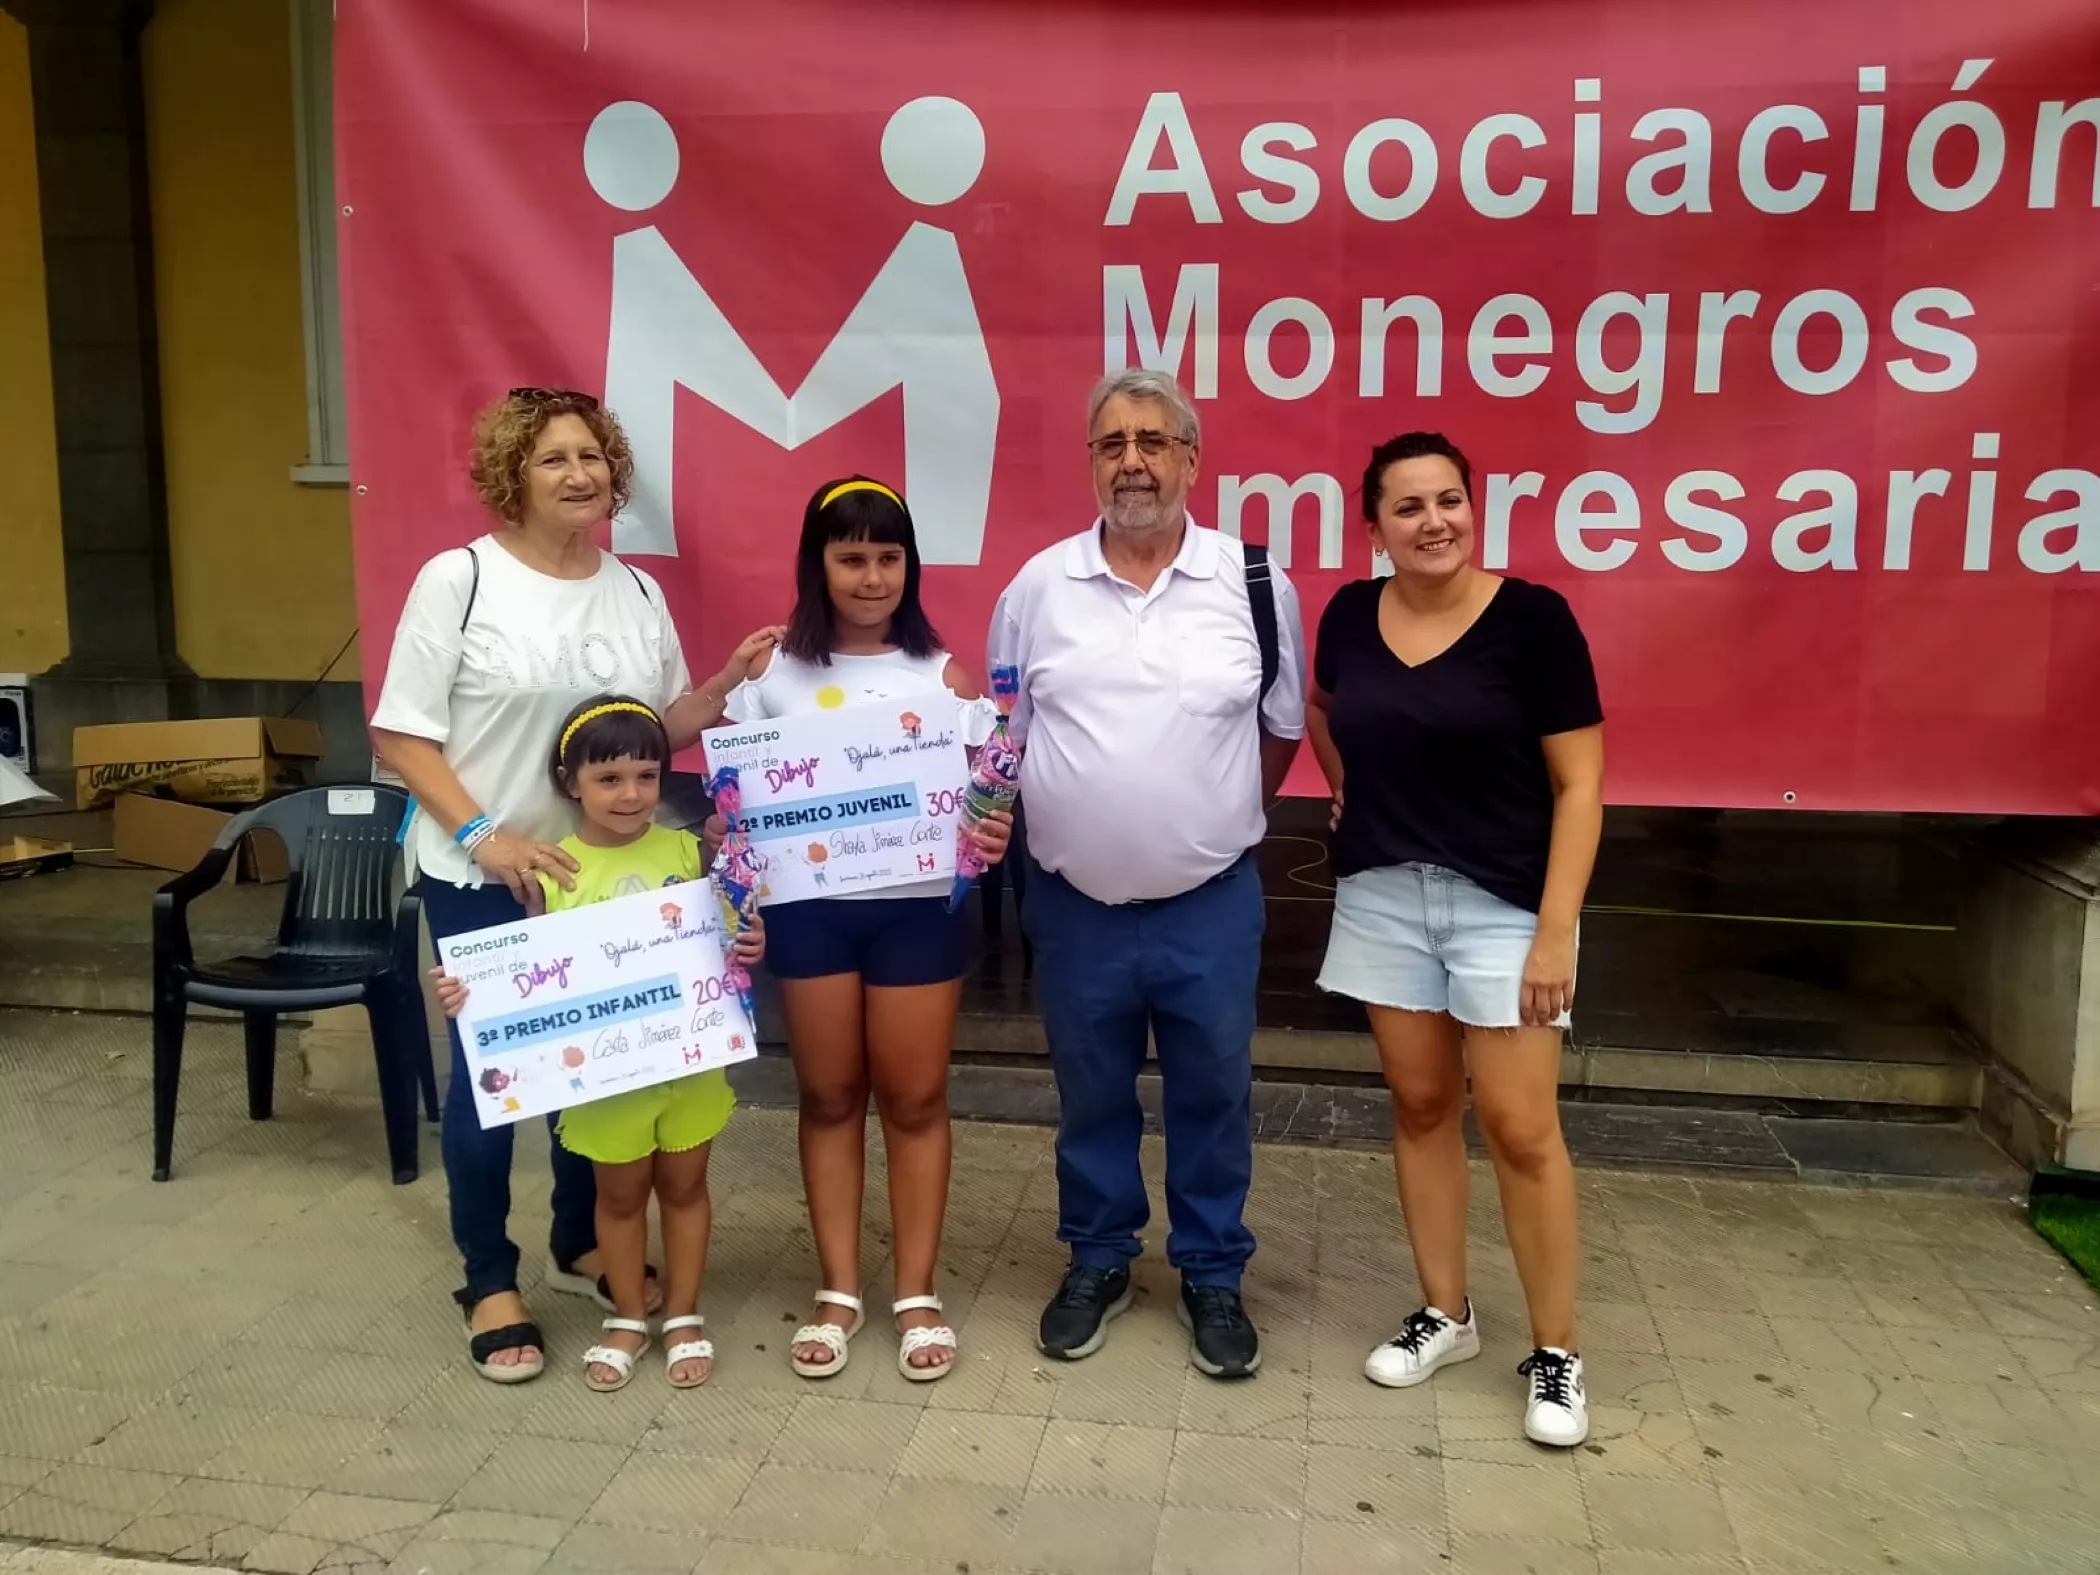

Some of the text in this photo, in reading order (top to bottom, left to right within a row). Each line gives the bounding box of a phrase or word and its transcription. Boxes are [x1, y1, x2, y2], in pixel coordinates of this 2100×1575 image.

[1103, 58, 2100, 226] Asociación
[1103, 262, 1979, 433] Monegros
[710, 730, 780, 749] Concurso
[889, 744, 912, 756] una
[761, 756, 779, 769] de
[764, 757, 820, 795] Dibujo
[763, 805, 832, 830] PREMIO
[837, 793, 912, 819] JUVENIL
[925, 786, 965, 818] 30€
[450, 932, 529, 958] Concurso
[648, 934, 674, 948] una
[460, 959, 528, 985] uvenil de
[512, 955, 573, 999] Dibujo
[692, 970, 738, 1006] 20€
[477, 984, 682, 1047] 3º PREMIO INFANTIL
